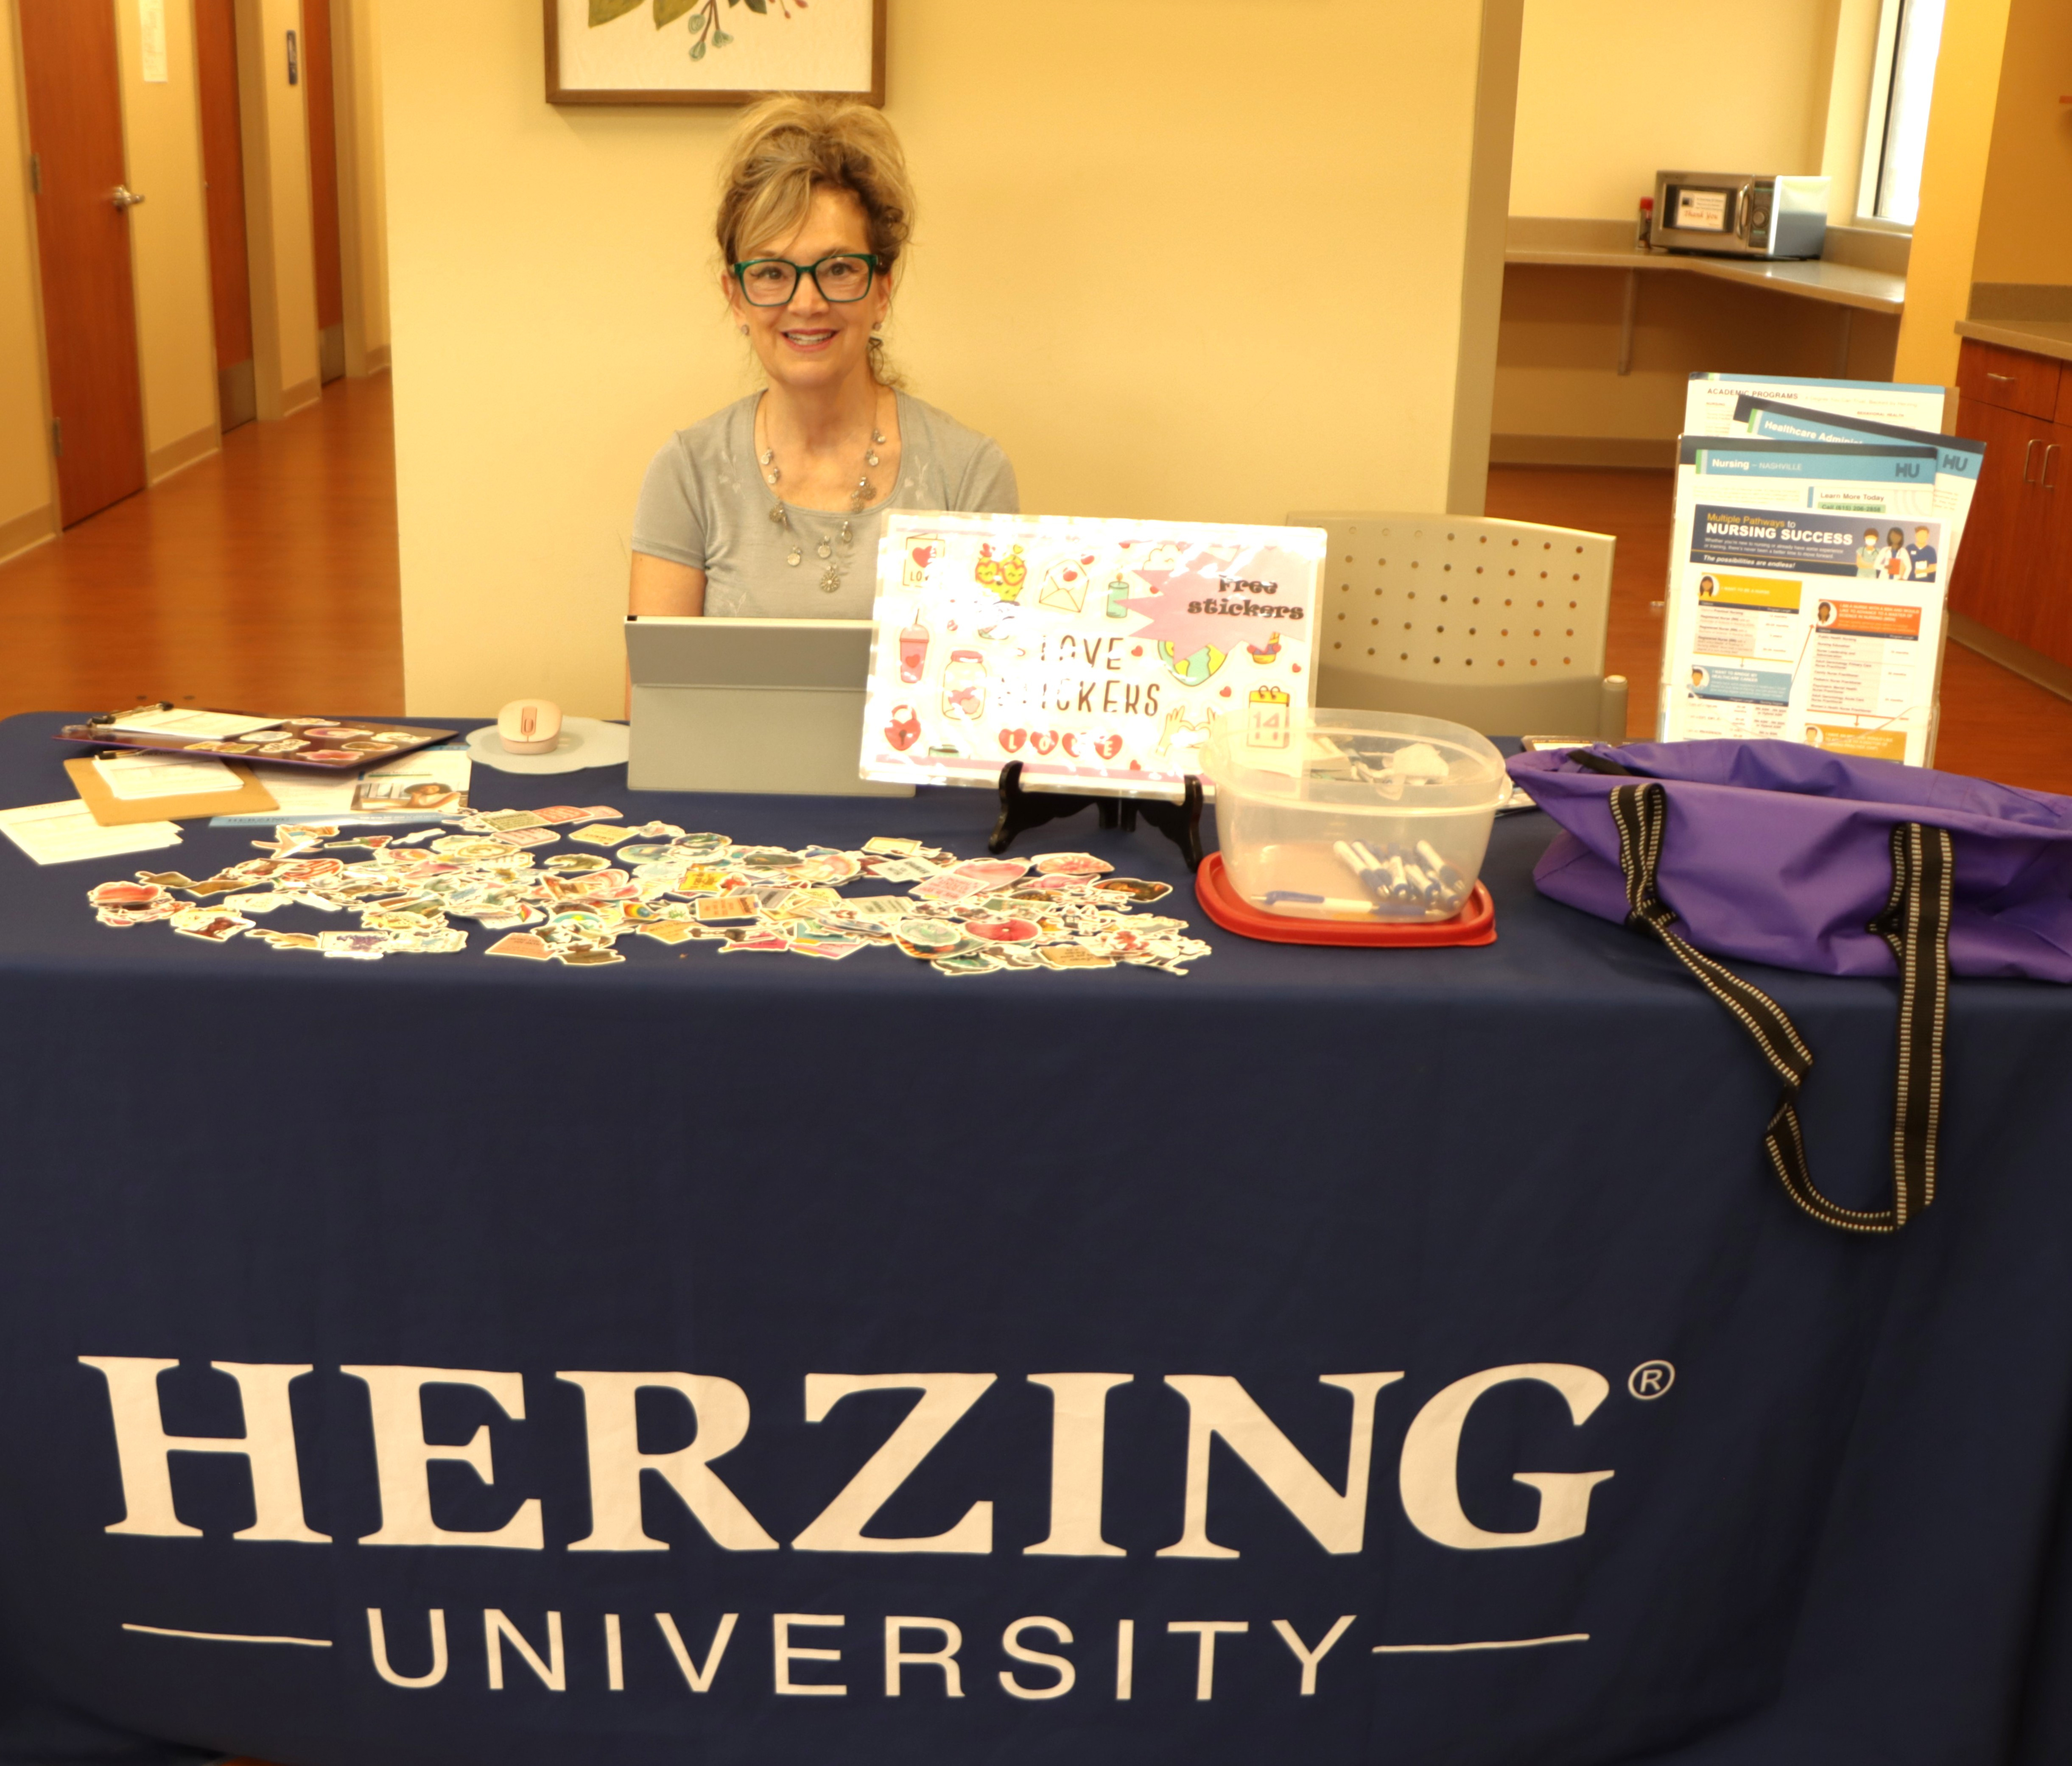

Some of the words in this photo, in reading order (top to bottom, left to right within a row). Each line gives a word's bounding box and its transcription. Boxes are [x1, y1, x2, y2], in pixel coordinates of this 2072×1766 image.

[1707, 388, 1750, 396] ACADEMIC
[1752, 390, 1798, 400] PROGRAMS
[1764, 420, 1817, 439] Healthcare
[1712, 458, 1750, 471] Nursing
[1759, 462, 1802, 471] NASHVILLE
[1895, 462, 1920, 478] HU
[1942, 454, 1969, 472] HU
[1863, 494, 1885, 502] Today
[1707, 513, 1741, 524] Multiple
[1743, 516, 1785, 528] Pathways
[1787, 520, 1796, 528] to
[1706, 522, 1776, 539] NURSING
[1781, 529, 1853, 545] SUCCESS
[1716, 556, 1755, 565] possibilities
[1767, 561, 1796, 569] endless!
[1219, 574, 1278, 594] Free
[1187, 598, 1304, 620] stickers
[1253, 711, 1280, 740] 14
[367, 1609, 1355, 1699] UNIVERSITY
